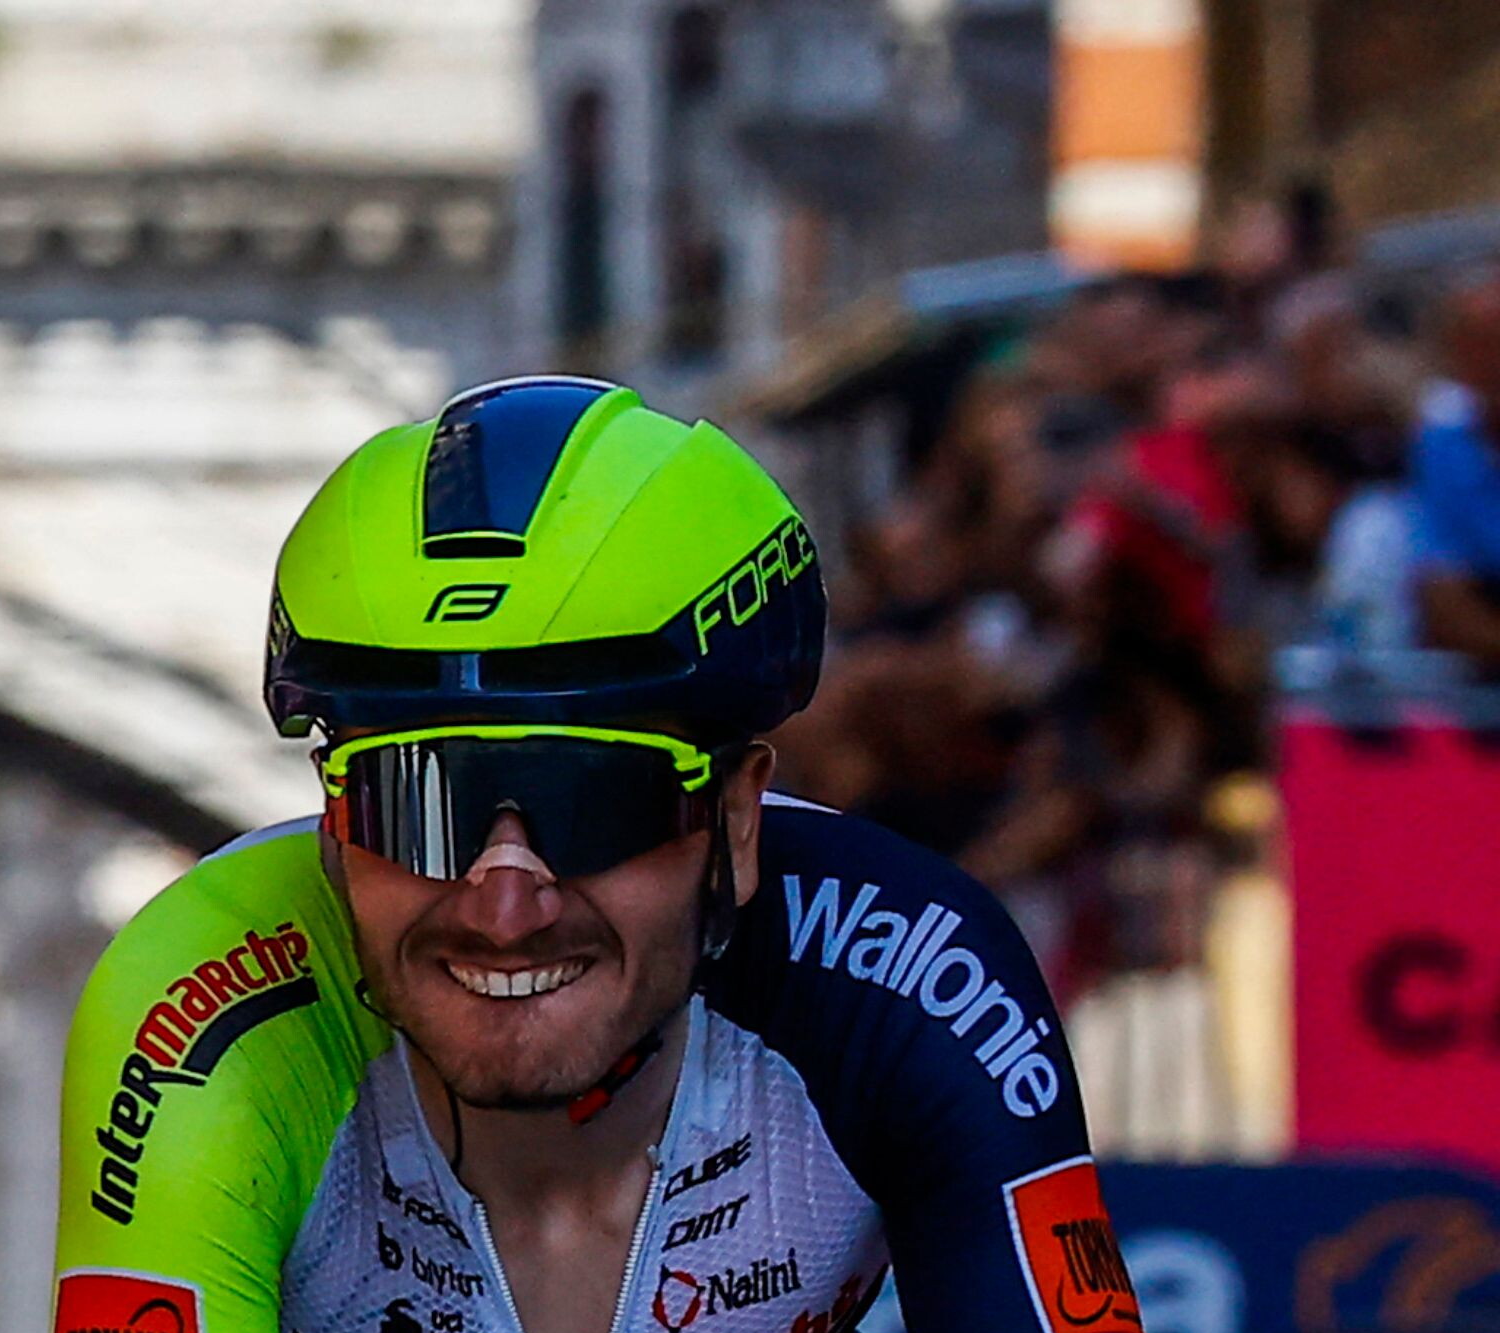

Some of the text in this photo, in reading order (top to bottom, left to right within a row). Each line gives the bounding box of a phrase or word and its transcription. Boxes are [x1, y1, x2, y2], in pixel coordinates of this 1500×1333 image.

[782, 873, 1059, 1118] Wallonie
[1357, 928, 1500, 1064] C
[662, 1133, 752, 1205] CUBE
[661, 1194, 751, 1252] DMT
[705, 1248, 802, 1315] Nalini
